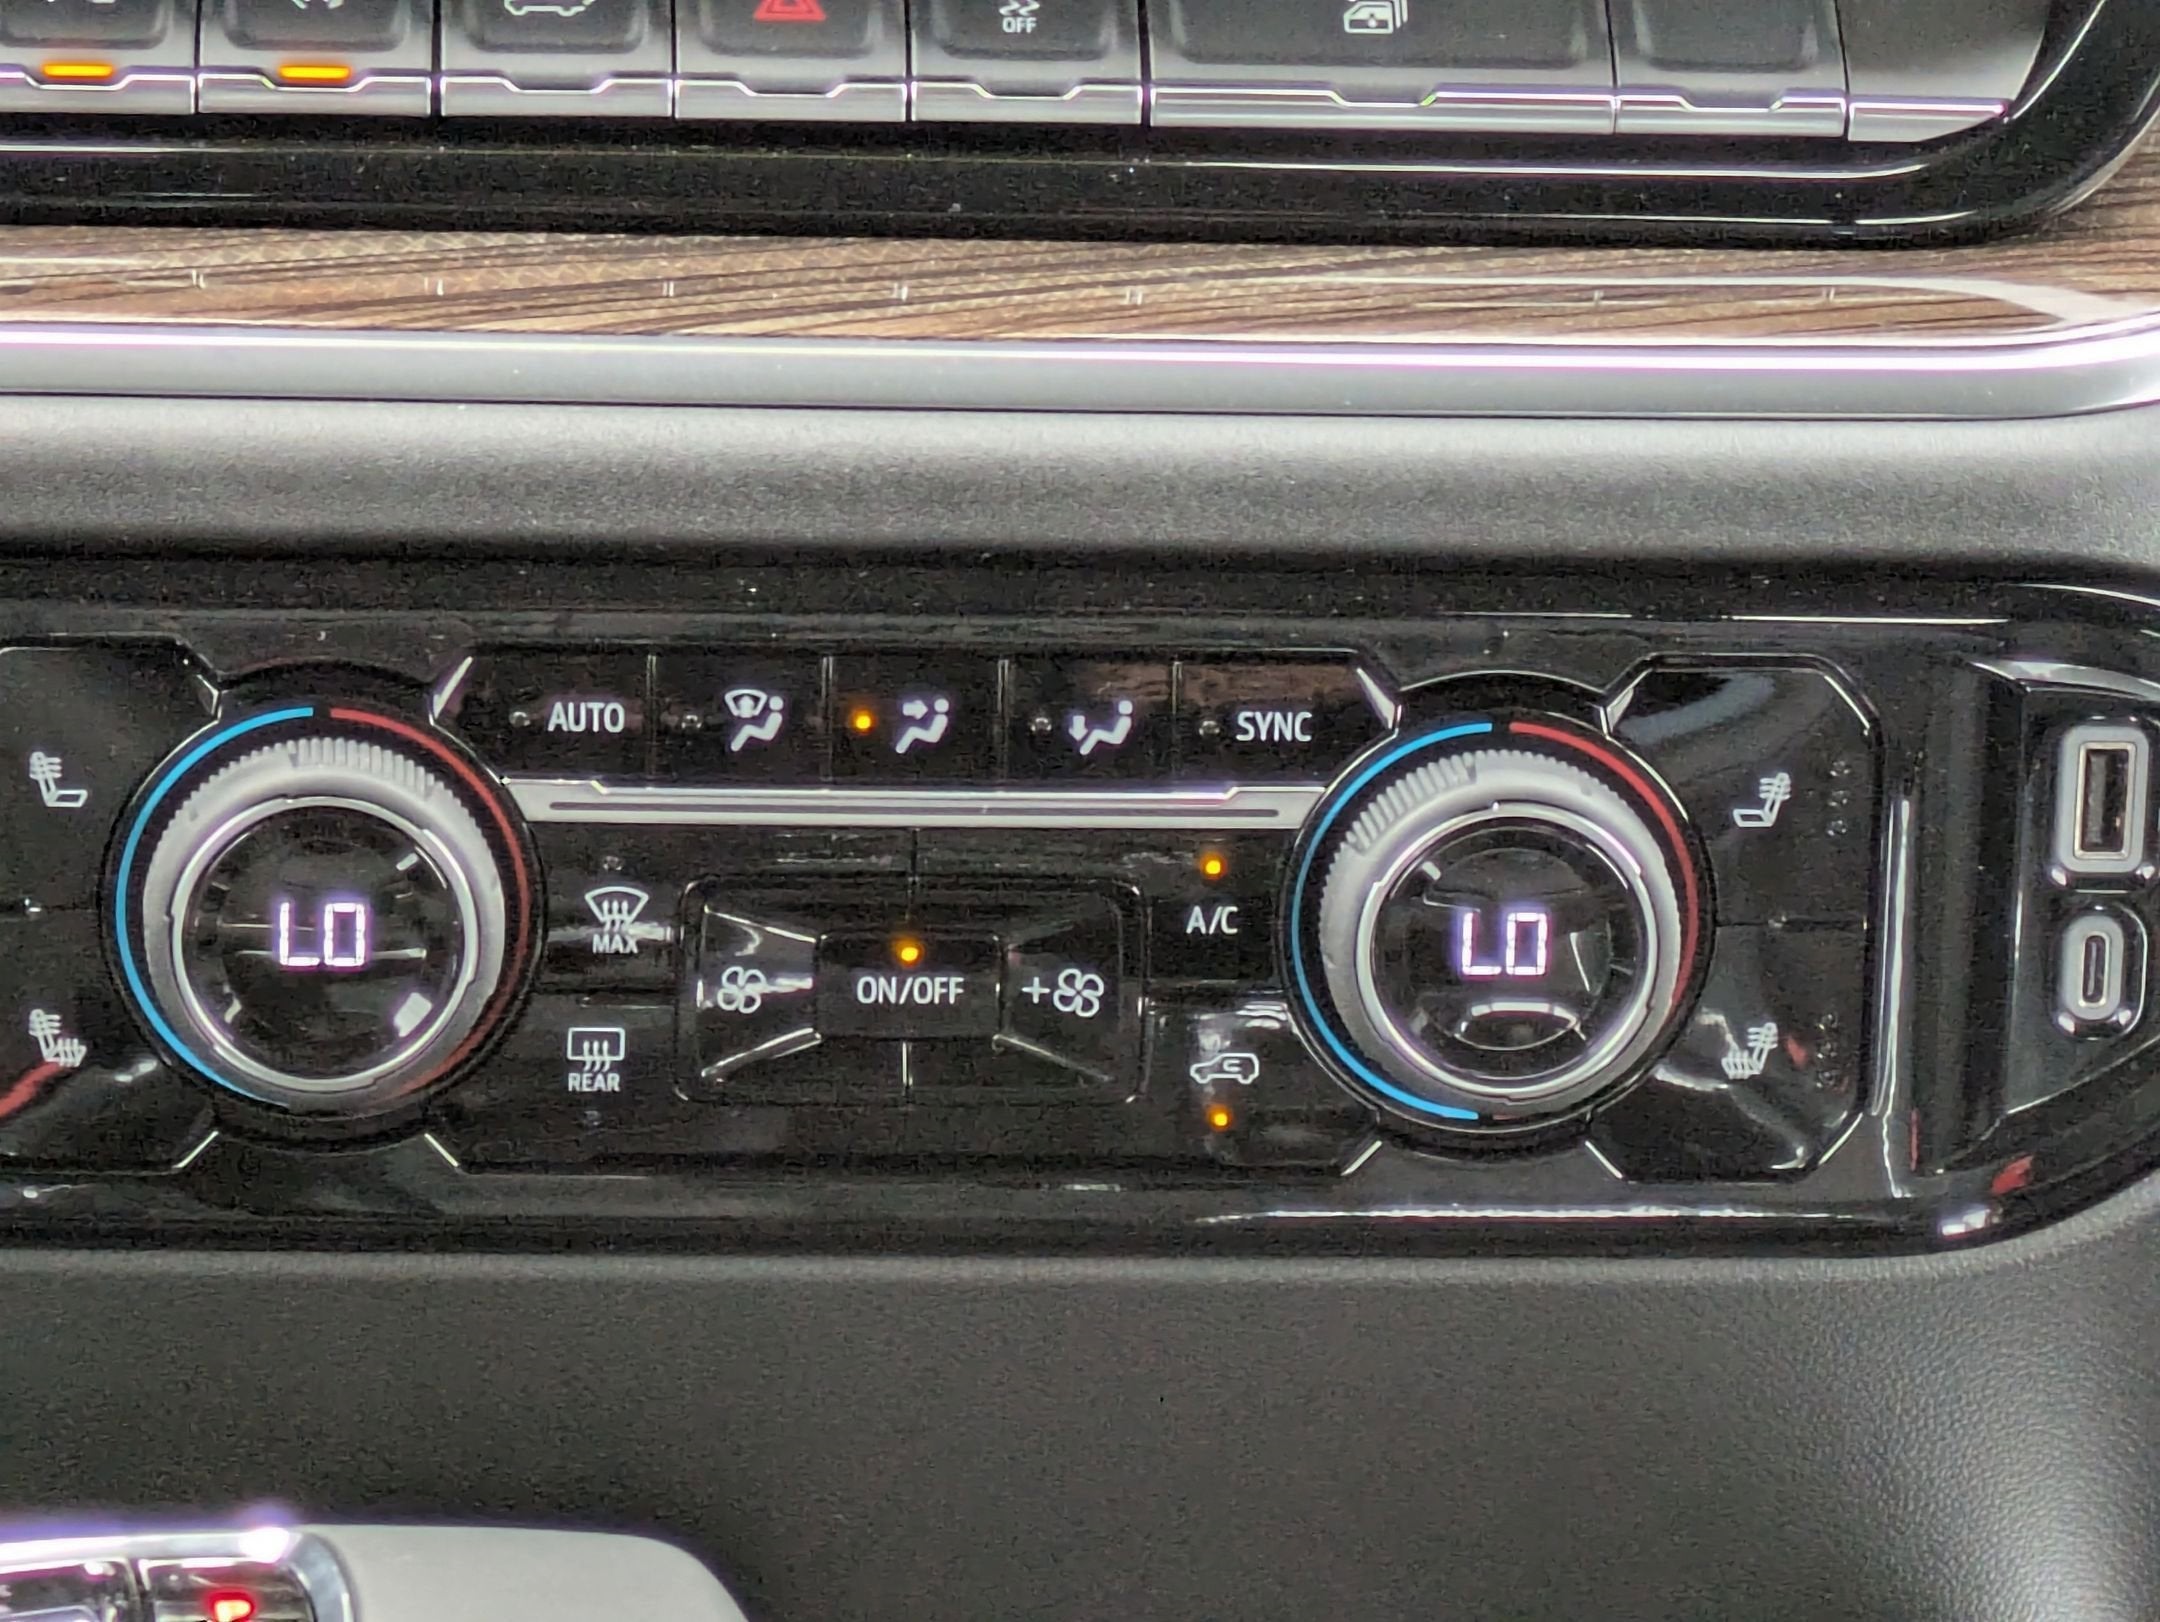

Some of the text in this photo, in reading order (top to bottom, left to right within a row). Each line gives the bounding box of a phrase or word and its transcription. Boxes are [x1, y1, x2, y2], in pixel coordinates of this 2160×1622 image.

[1002, 16, 1037, 33] OFF
[547, 701, 626, 733] AUTO
[1235, 711, 1313, 742] SYNC
[277, 901, 368, 967] LO
[1186, 905, 1239, 936] A/C
[592, 934, 640, 954] MAX
[1460, 910, 1549, 976] LO
[857, 975, 966, 1005] ON/OFF
[568, 1072, 621, 1093] REAR
